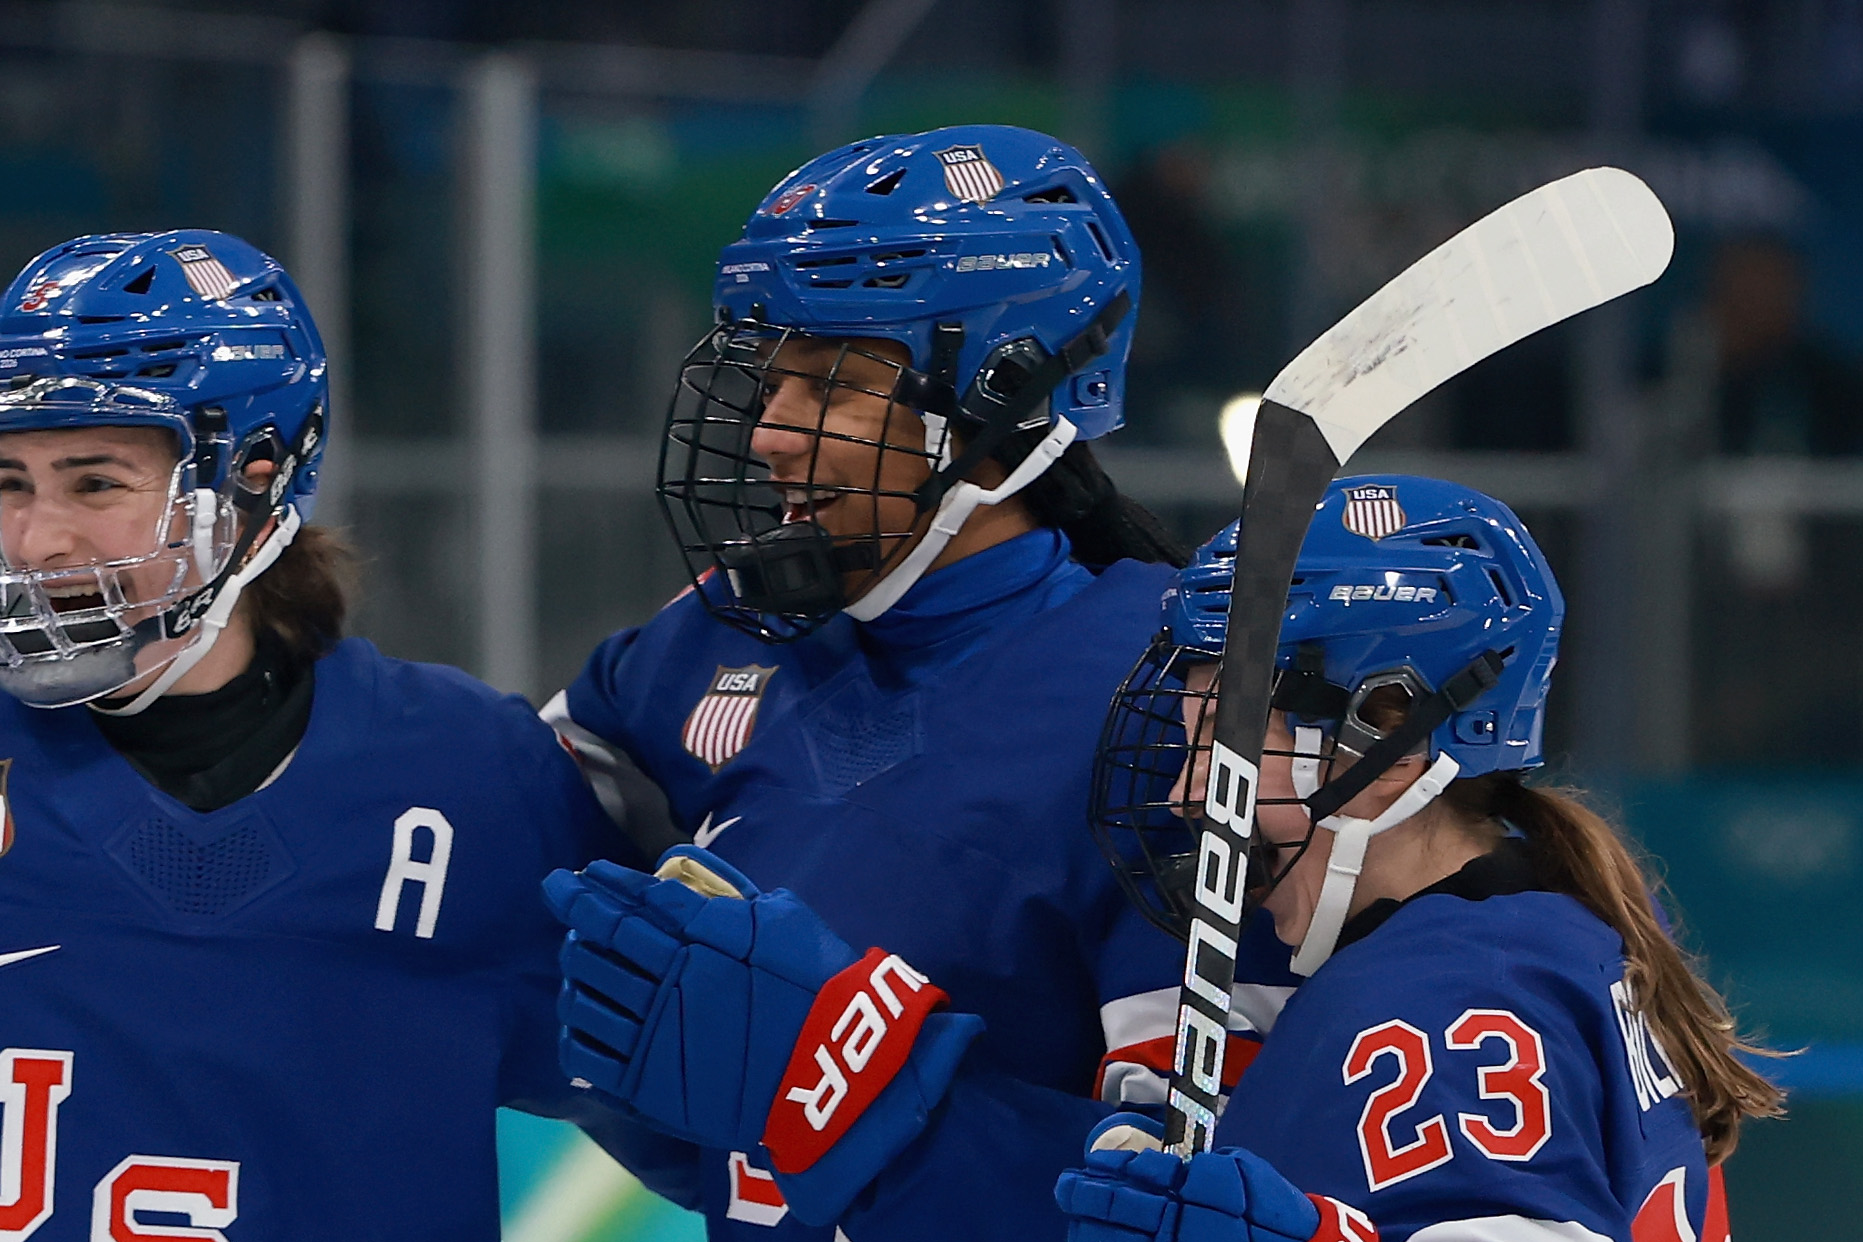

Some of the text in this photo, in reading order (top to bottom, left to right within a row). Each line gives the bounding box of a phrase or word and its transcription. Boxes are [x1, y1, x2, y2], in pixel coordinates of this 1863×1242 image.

[943, 150, 979, 163] USA
[177, 249, 210, 262] USA
[1353, 489, 1389, 499] USA
[1328, 585, 1437, 603] BAUER
[716, 673, 758, 691] USA
[375, 807, 454, 939] A
[1343, 1009, 1552, 1192] 23
